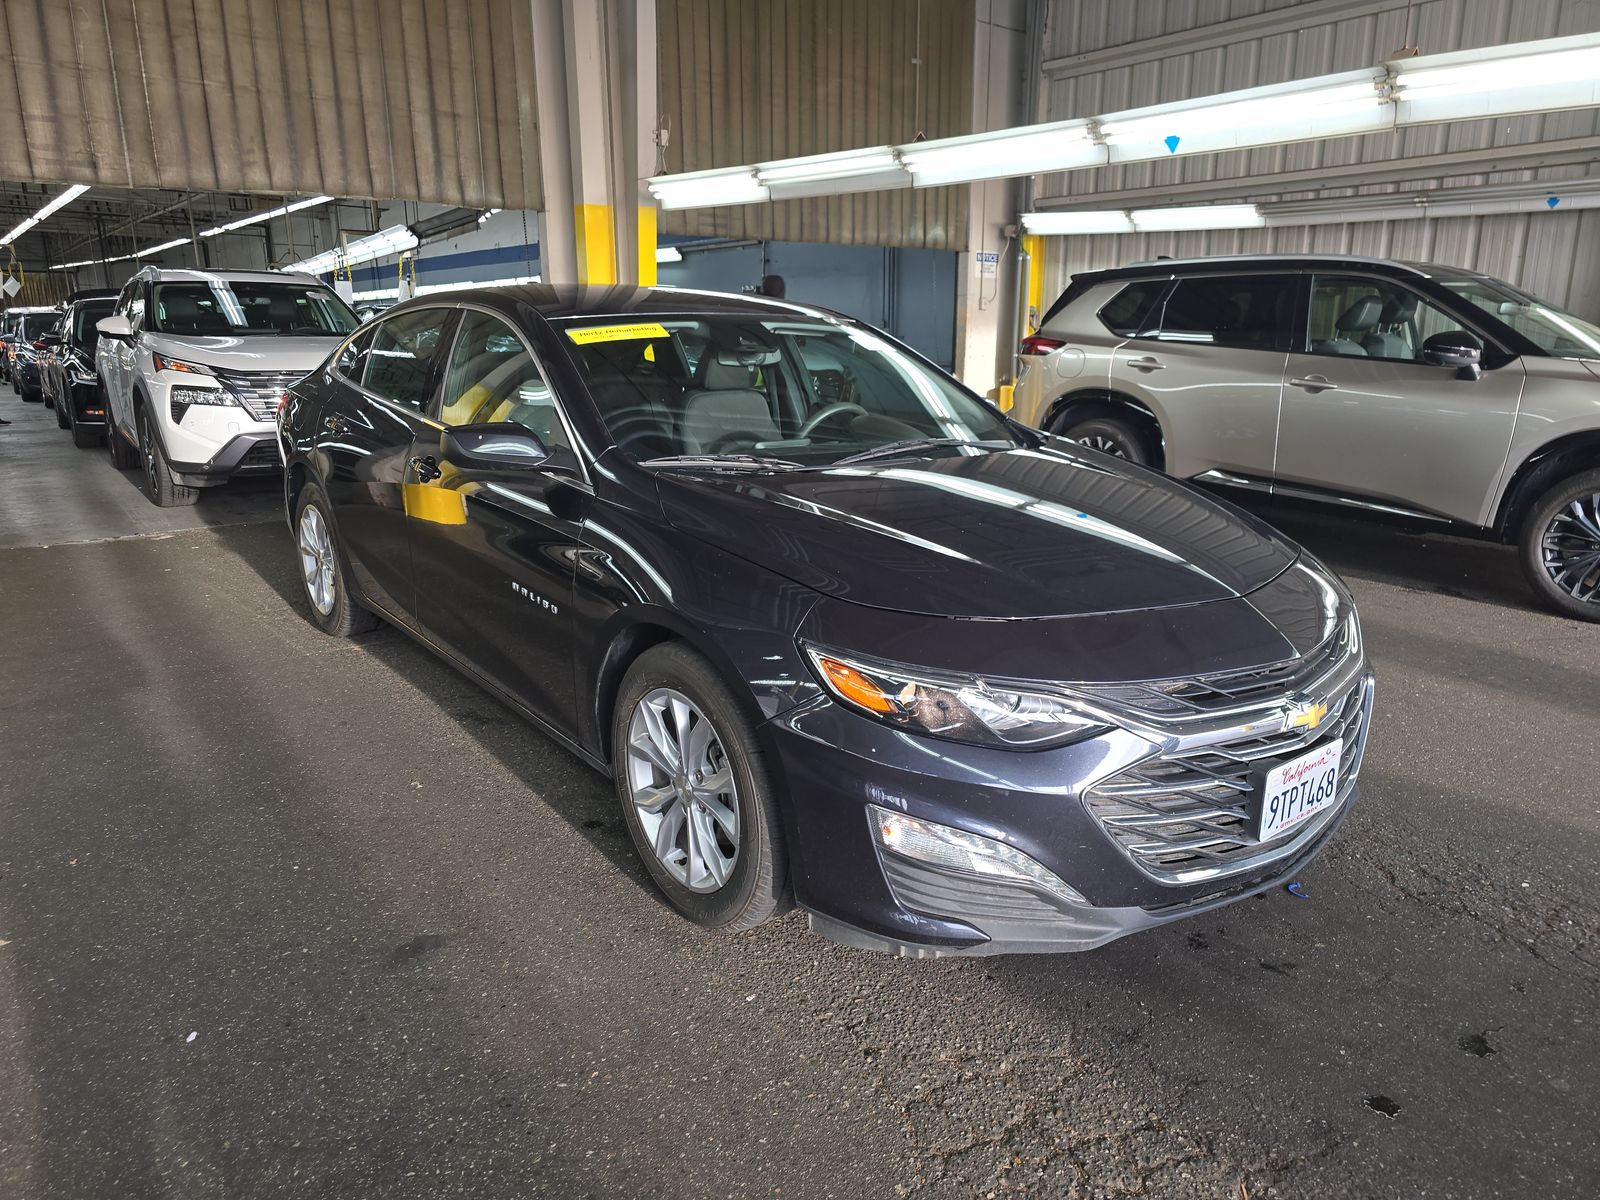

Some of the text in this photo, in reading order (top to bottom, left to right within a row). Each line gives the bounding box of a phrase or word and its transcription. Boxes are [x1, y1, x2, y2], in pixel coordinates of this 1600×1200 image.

[511, 581, 558, 614] MALIBU
[1282, 757, 1328, 785] California
[1268, 768, 1335, 829] 9TPT468
